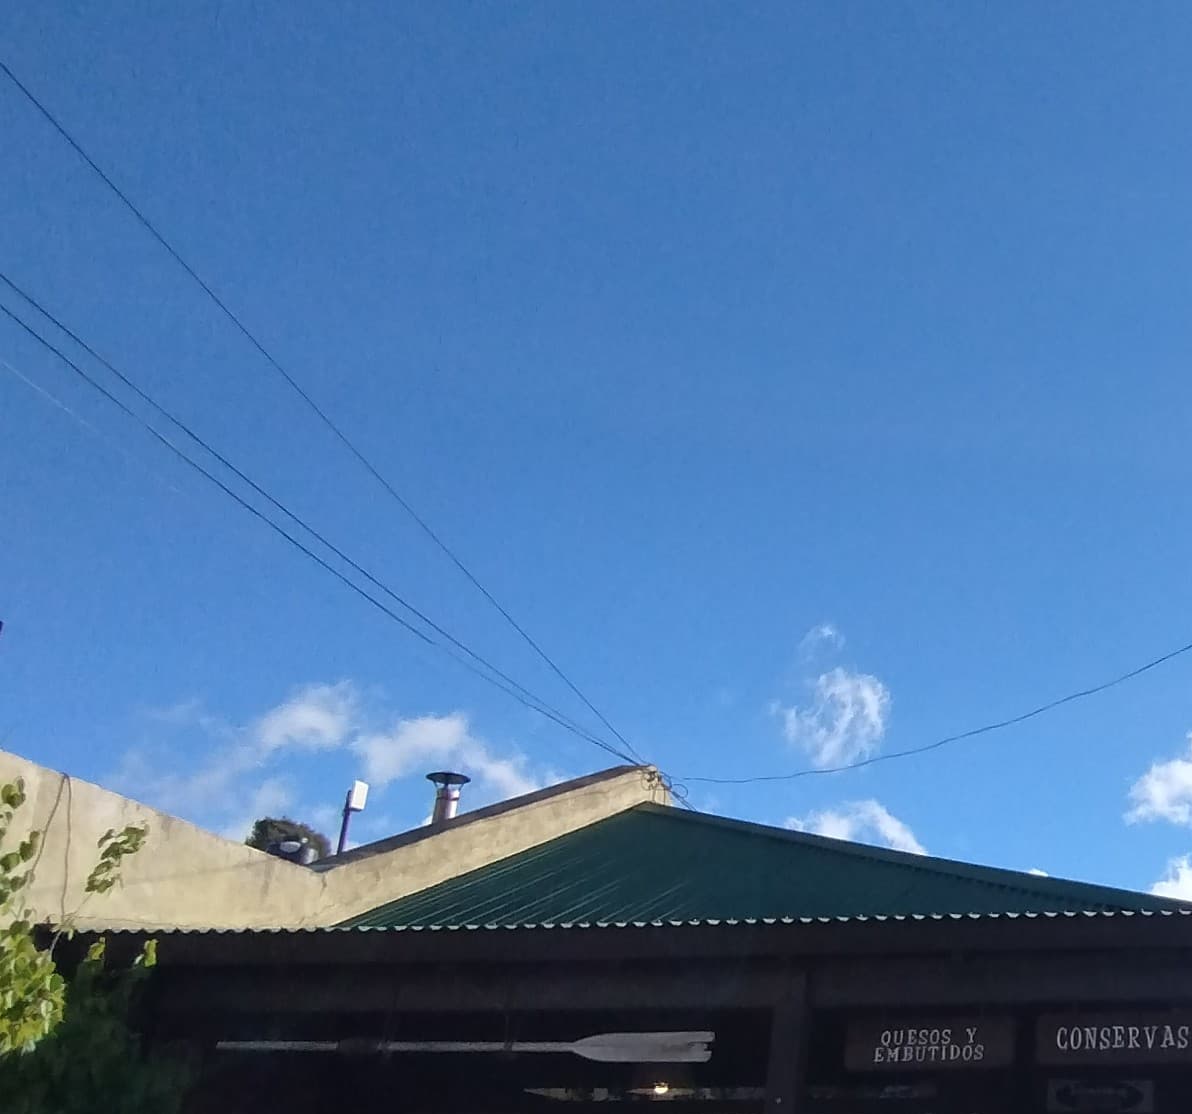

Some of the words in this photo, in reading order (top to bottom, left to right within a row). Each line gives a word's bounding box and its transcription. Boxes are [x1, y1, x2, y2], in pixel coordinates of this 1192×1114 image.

[880, 1029, 952, 1046] QUESOS
[965, 1027, 977, 1044] Y
[1056, 1025, 1190, 1050] CONSERVAS
[873, 1044, 985, 1062] EMBUTIDOS
